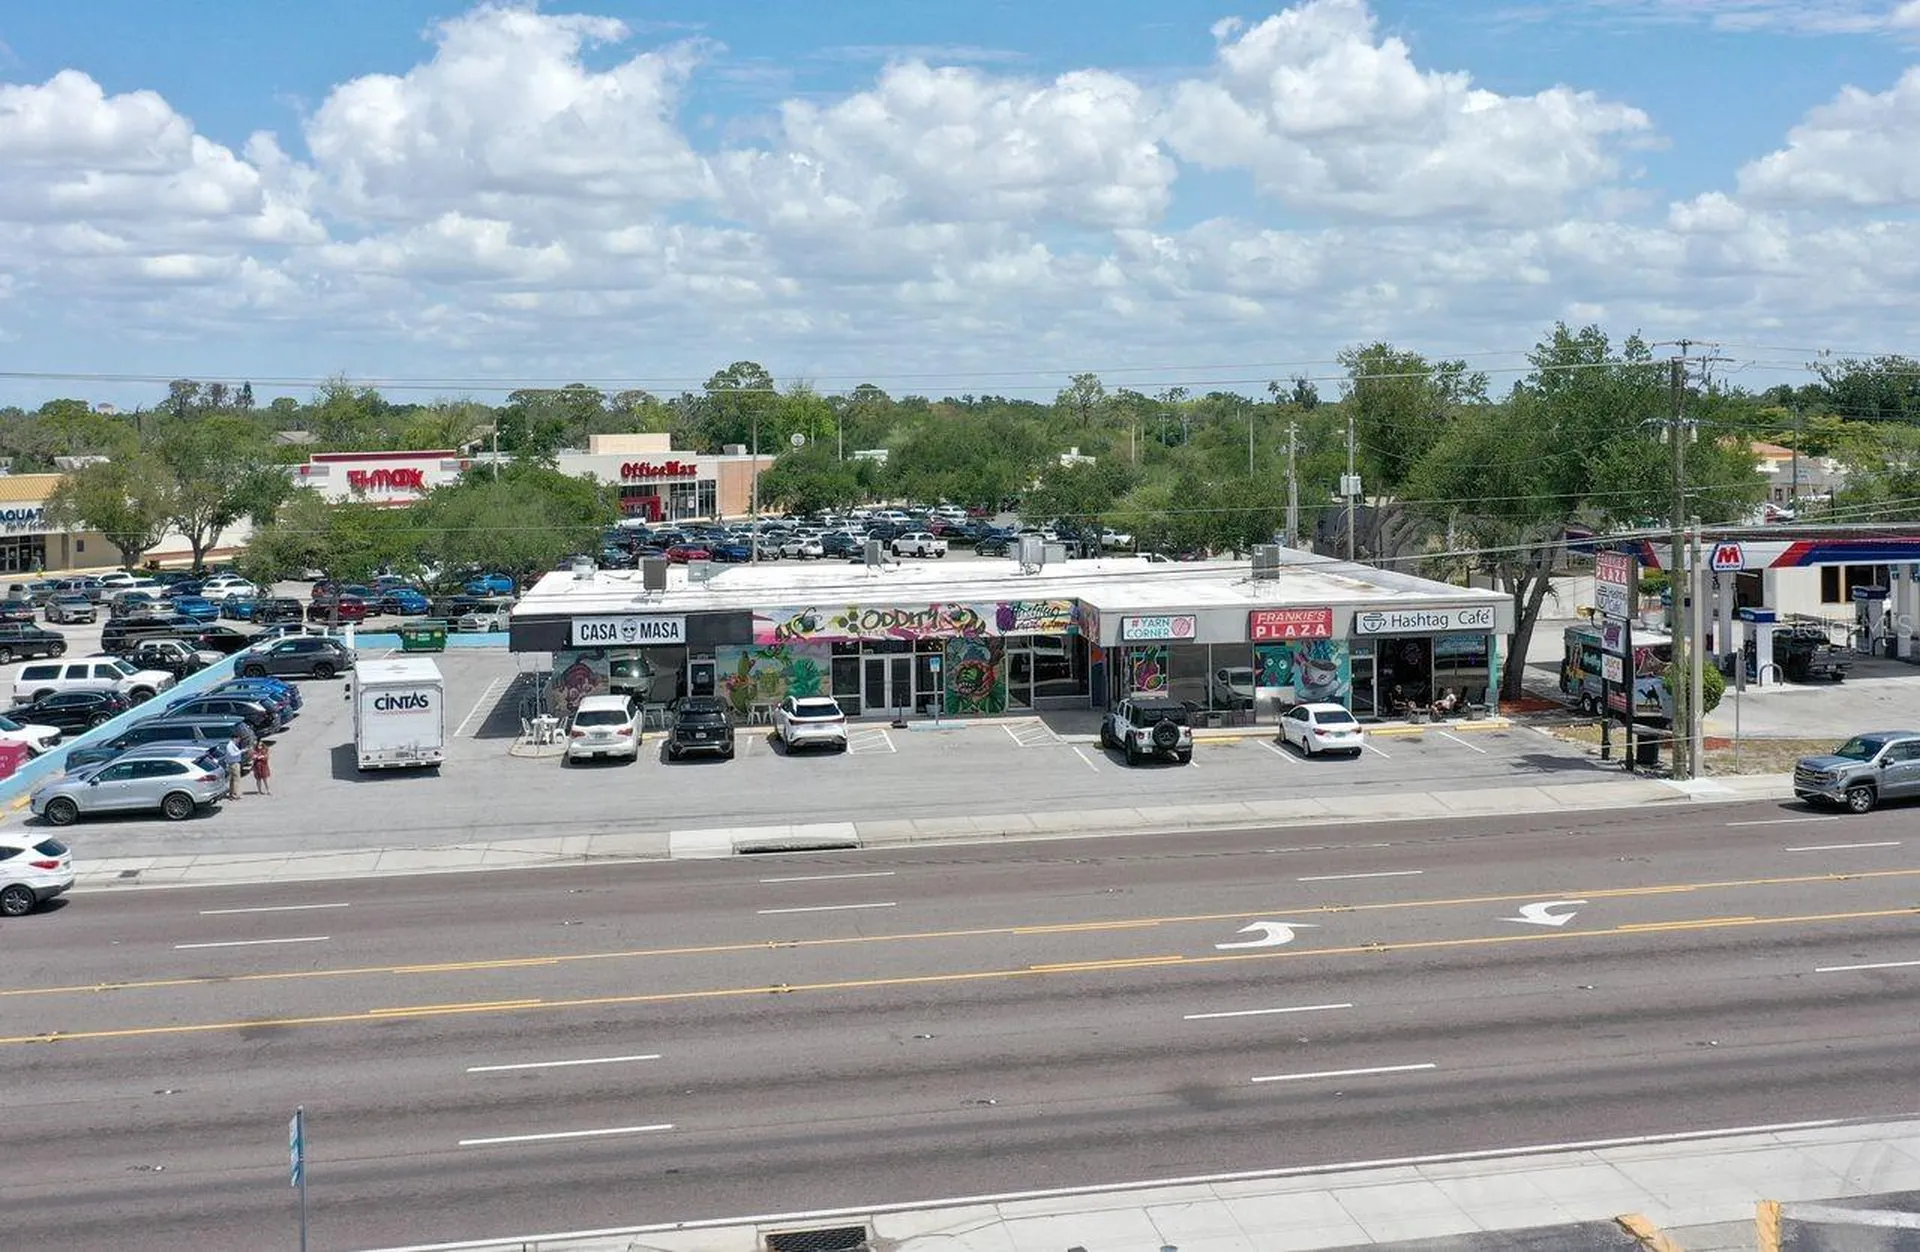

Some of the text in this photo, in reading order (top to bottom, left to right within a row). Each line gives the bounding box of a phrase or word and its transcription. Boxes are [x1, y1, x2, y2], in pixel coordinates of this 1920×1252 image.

[620, 460, 697, 478] OfficeMax
[1596, 566, 1628, 584] PLAZA
[861, 607, 938, 630] ODDITY
[1131, 617, 1170, 627] # YARN
[1256, 611, 1326, 624] FRANKIE'S
[1391, 609, 1491, 628] Hashtag Café
[581, 621, 679, 640] CASA MASA
[1126, 626, 1170, 638] CORNER
[1256, 624, 1327, 638] PLAZA
[374, 690, 429, 711] CINTAS
